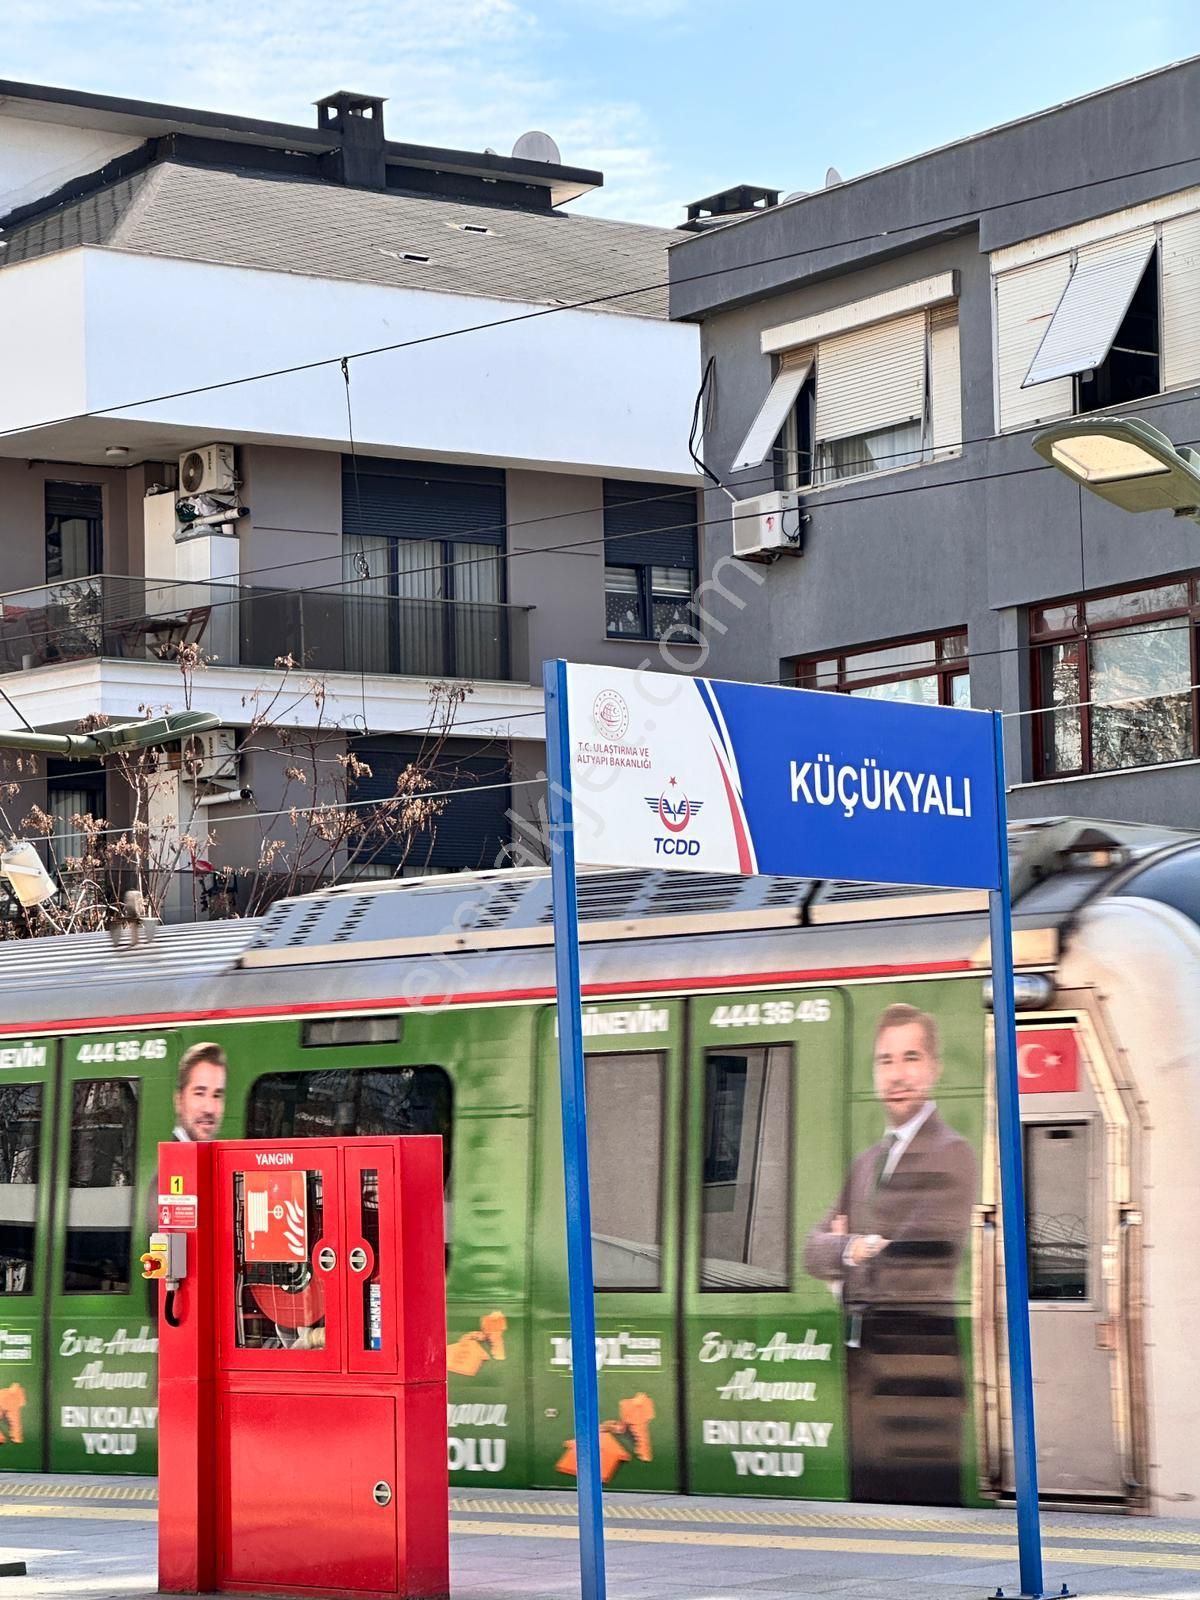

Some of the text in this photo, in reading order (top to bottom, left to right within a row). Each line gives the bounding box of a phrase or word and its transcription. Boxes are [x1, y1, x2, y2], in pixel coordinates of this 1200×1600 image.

[577, 753, 652, 769] ALTYAPI BAKANLIĞI
[578, 742, 650, 758] T.C. ULAŞTIRMA VE
[790, 753, 972, 818] KÜÇÜKYALI
[653, 838, 701, 855] TCDD
[554, 1003, 670, 1037] İNEVİM
[709, 1003, 760, 1029] 444
[76, 1042, 116, 1063] 444
[255, 1152, 294, 1166] YANGIN
[174, 1178, 180, 1192] 1
[61, 1405, 158, 1428] EN KOLAY
[81, 1433, 137, 1455] YOLU
[703, 1420, 834, 1447] EN KOLAY
[731, 1451, 805, 1477] YOLU
